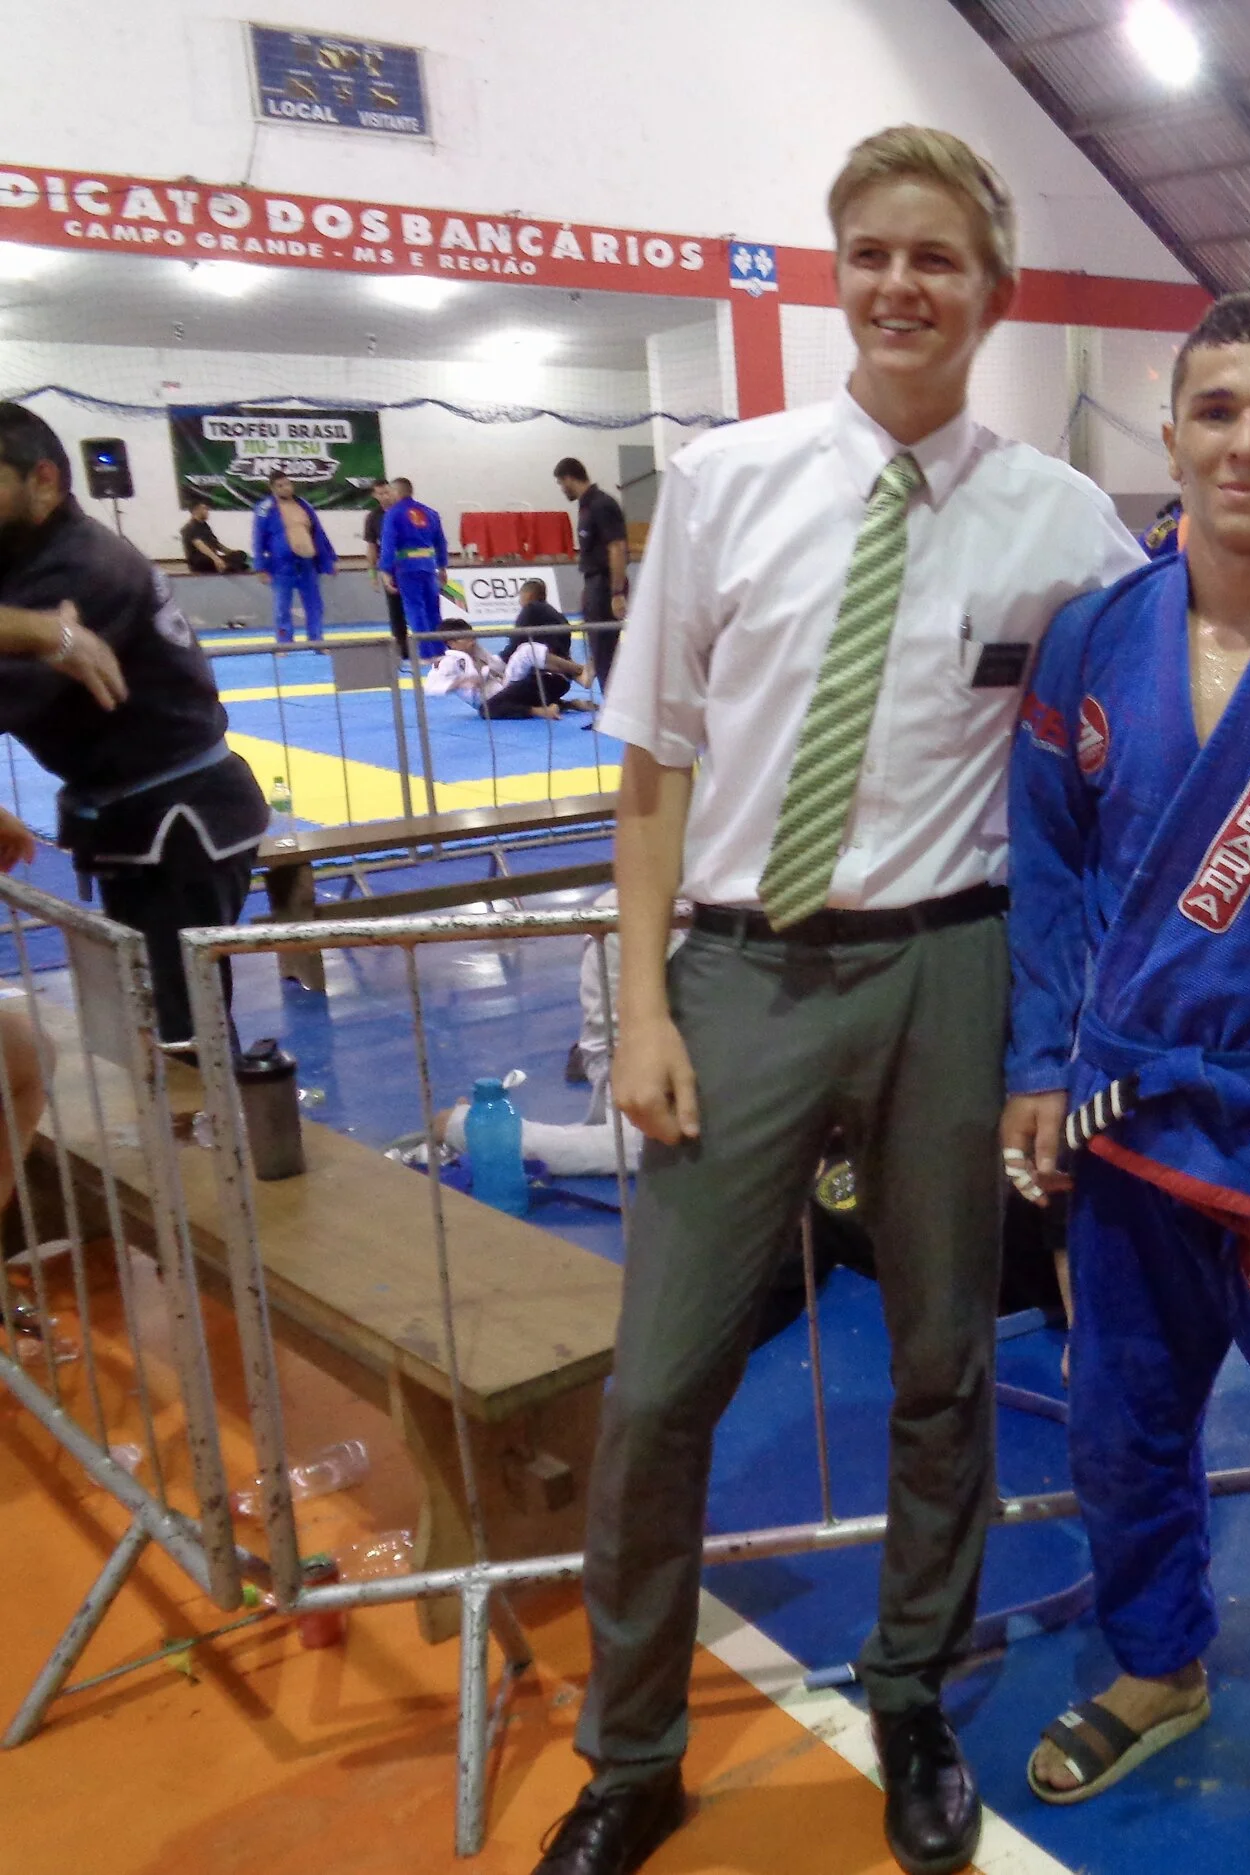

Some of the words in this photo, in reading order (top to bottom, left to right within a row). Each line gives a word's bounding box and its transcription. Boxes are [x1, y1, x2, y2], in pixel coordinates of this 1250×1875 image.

[266, 98, 340, 124] LOCAL
[64, 219, 186, 247] CAMPO
[195, 231, 324, 258] GRANDE
[352, 246, 395, 265] MS
[409, 252, 424, 268] E
[438, 255, 538, 277] REGIÃO
[265, 198, 390, 244] DOS
[401, 212, 705, 272] BANCÁRIOS
[287, 424, 348, 440] BRASIL
